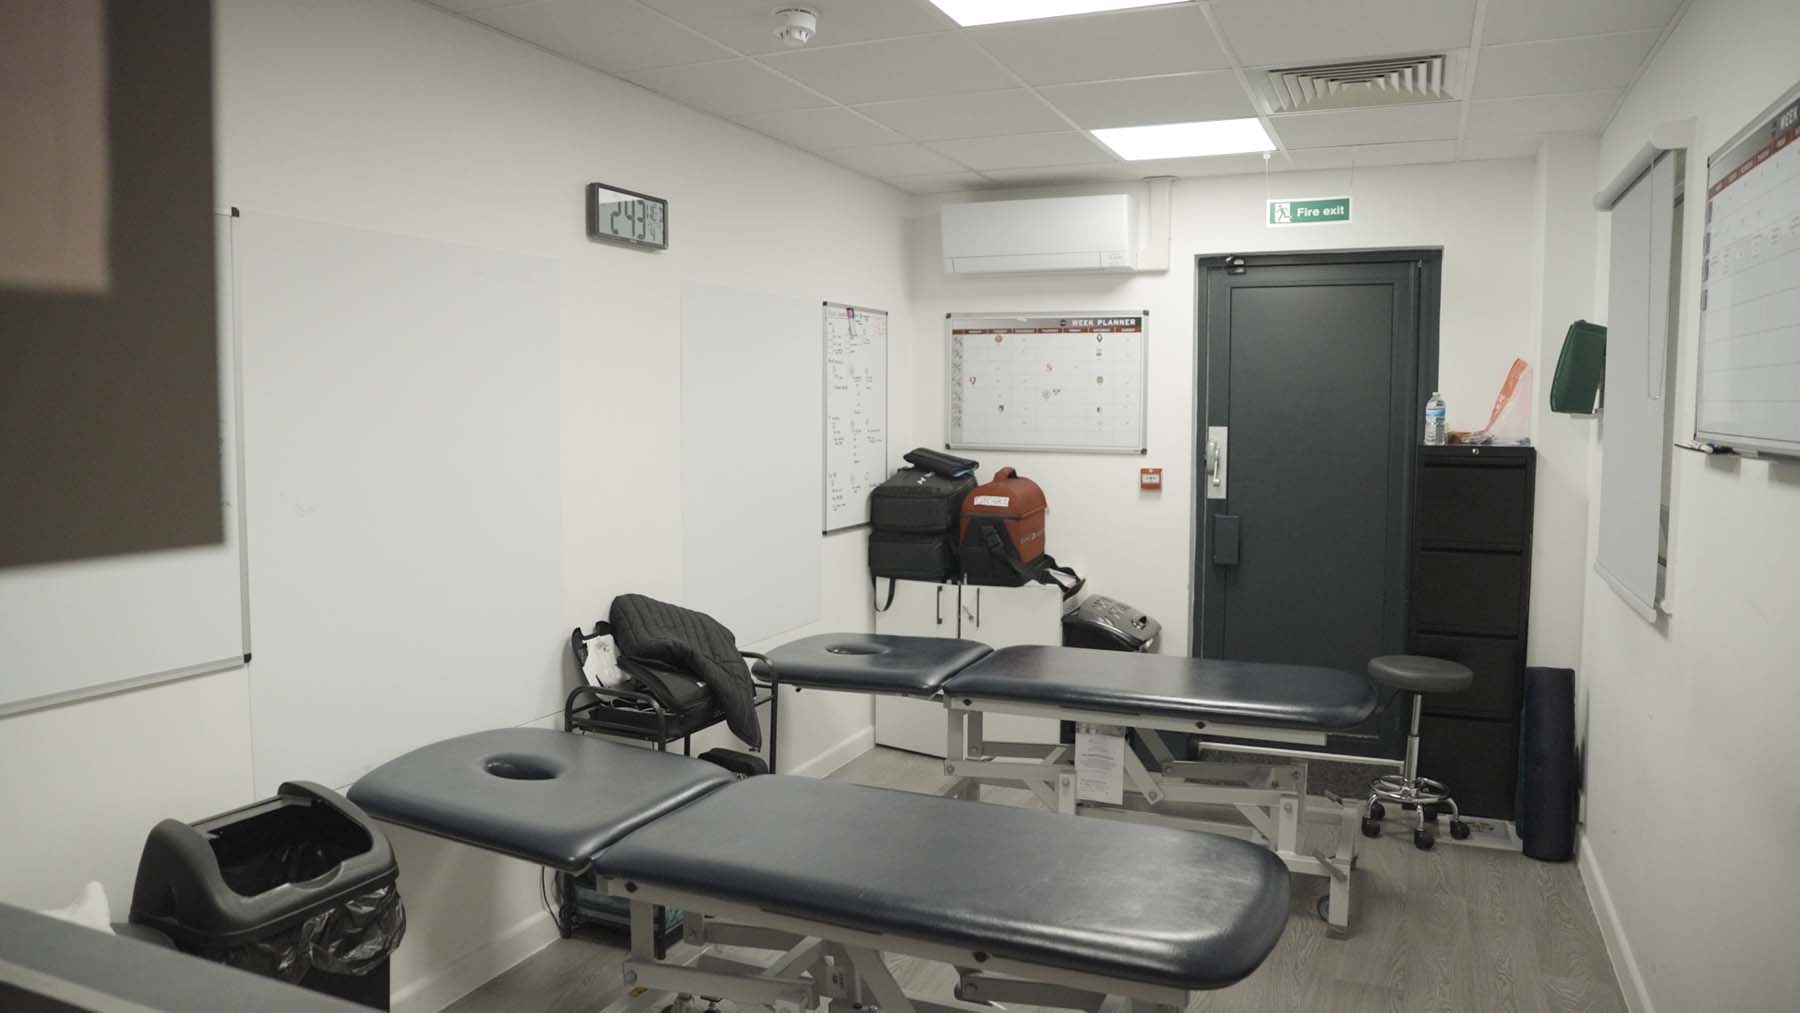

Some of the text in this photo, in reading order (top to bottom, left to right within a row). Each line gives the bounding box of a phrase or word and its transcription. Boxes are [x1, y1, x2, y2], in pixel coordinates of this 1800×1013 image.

[1296, 205, 1345, 217] Fire exit
[1071, 318, 1136, 327] WEEK PLANNER
